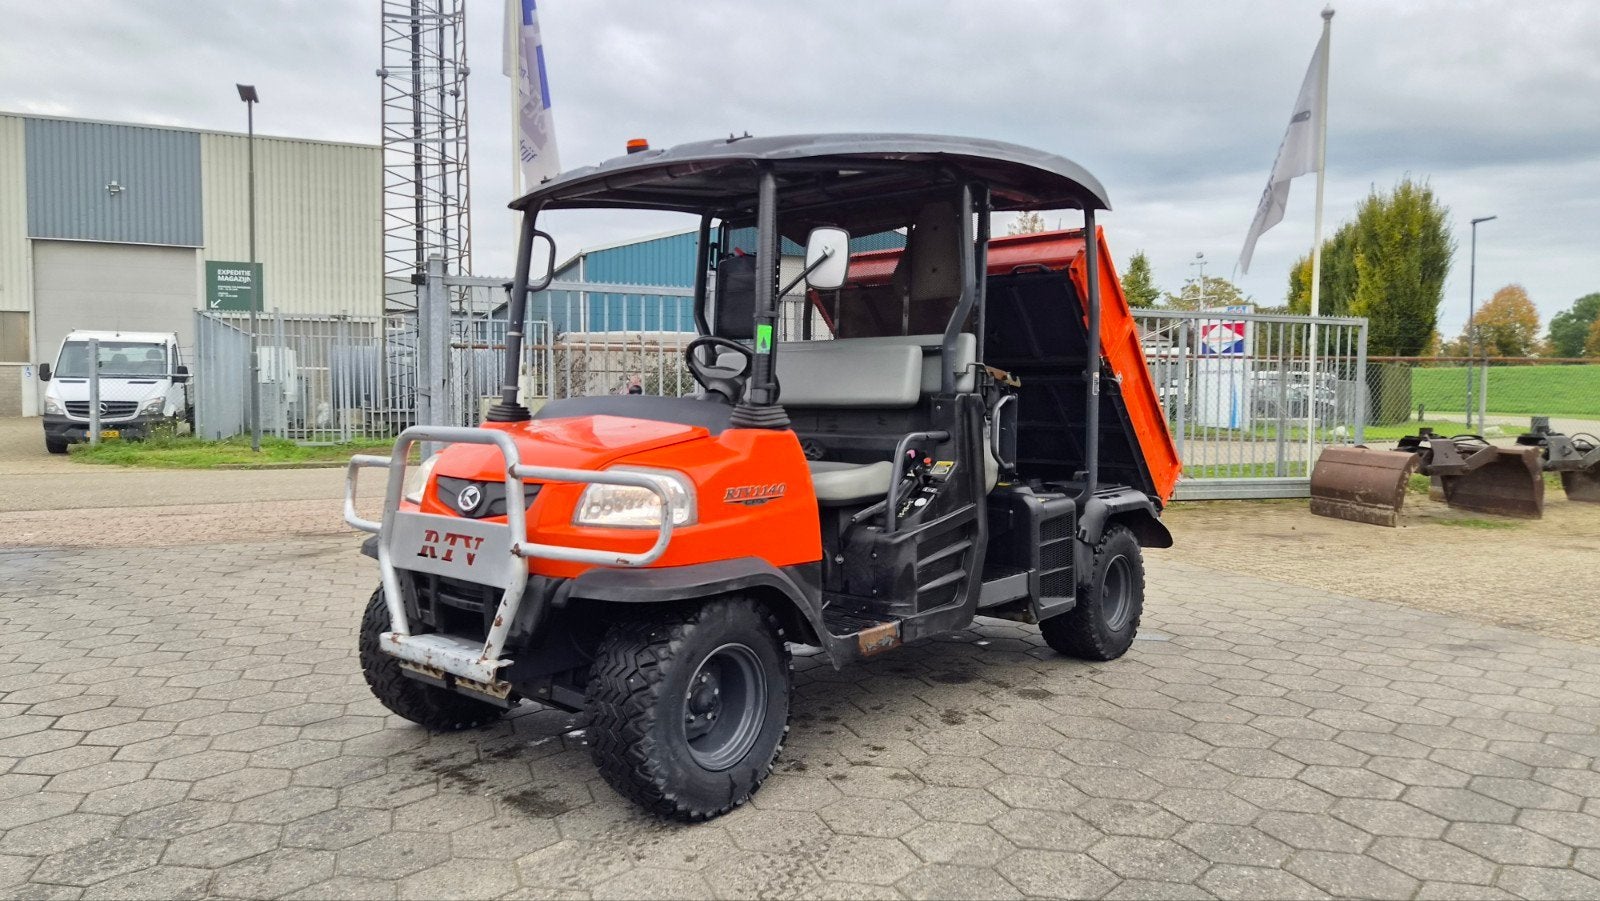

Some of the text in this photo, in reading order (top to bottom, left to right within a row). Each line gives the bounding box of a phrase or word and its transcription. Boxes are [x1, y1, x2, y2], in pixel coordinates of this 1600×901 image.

[217, 275, 251, 283] MAGAZIJN
[723, 483, 786, 500] RTV1140
[417, 529, 485, 566] RTV
